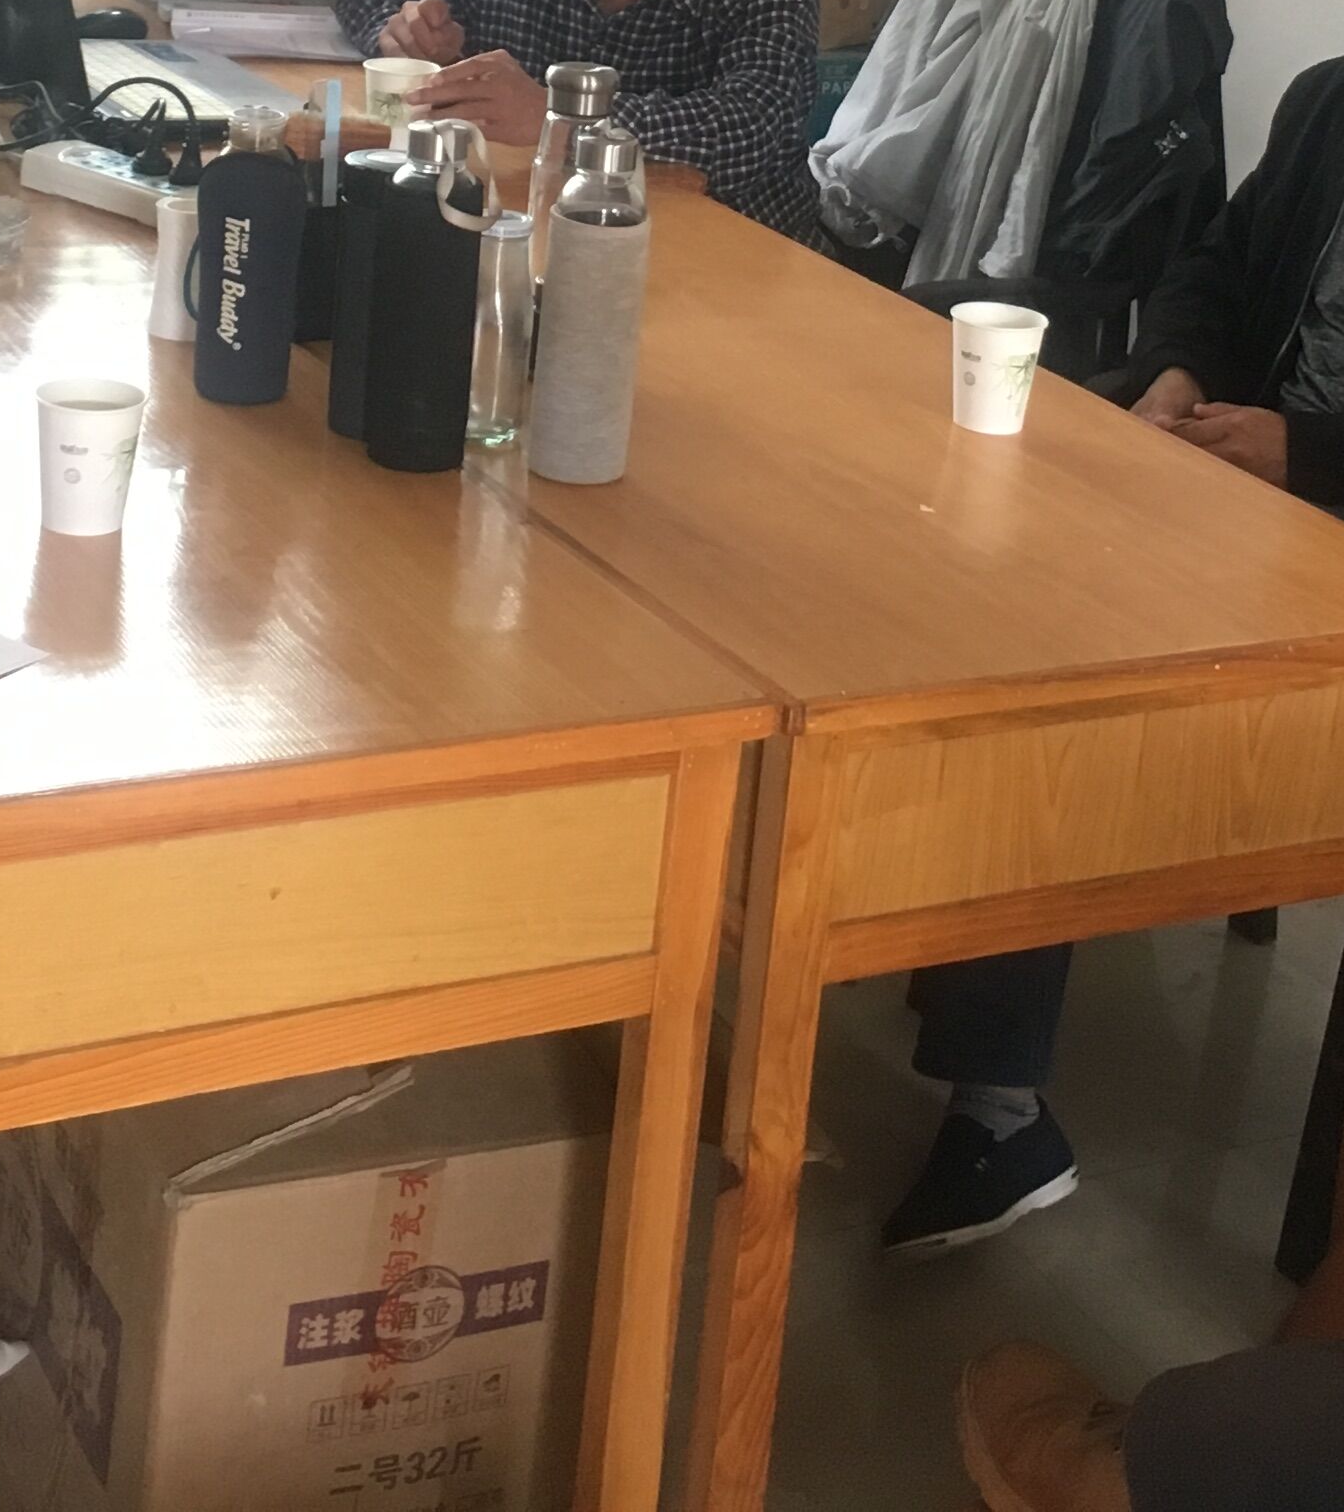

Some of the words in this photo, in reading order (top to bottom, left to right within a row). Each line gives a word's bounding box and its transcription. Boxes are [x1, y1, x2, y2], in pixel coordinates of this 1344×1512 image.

[224, 216, 251, 276] Travel
[216, 278, 246, 345] Buddy
[297, 1308, 366, 1350] 注浆
[329, 1436, 483, 1496] 二号32斤
